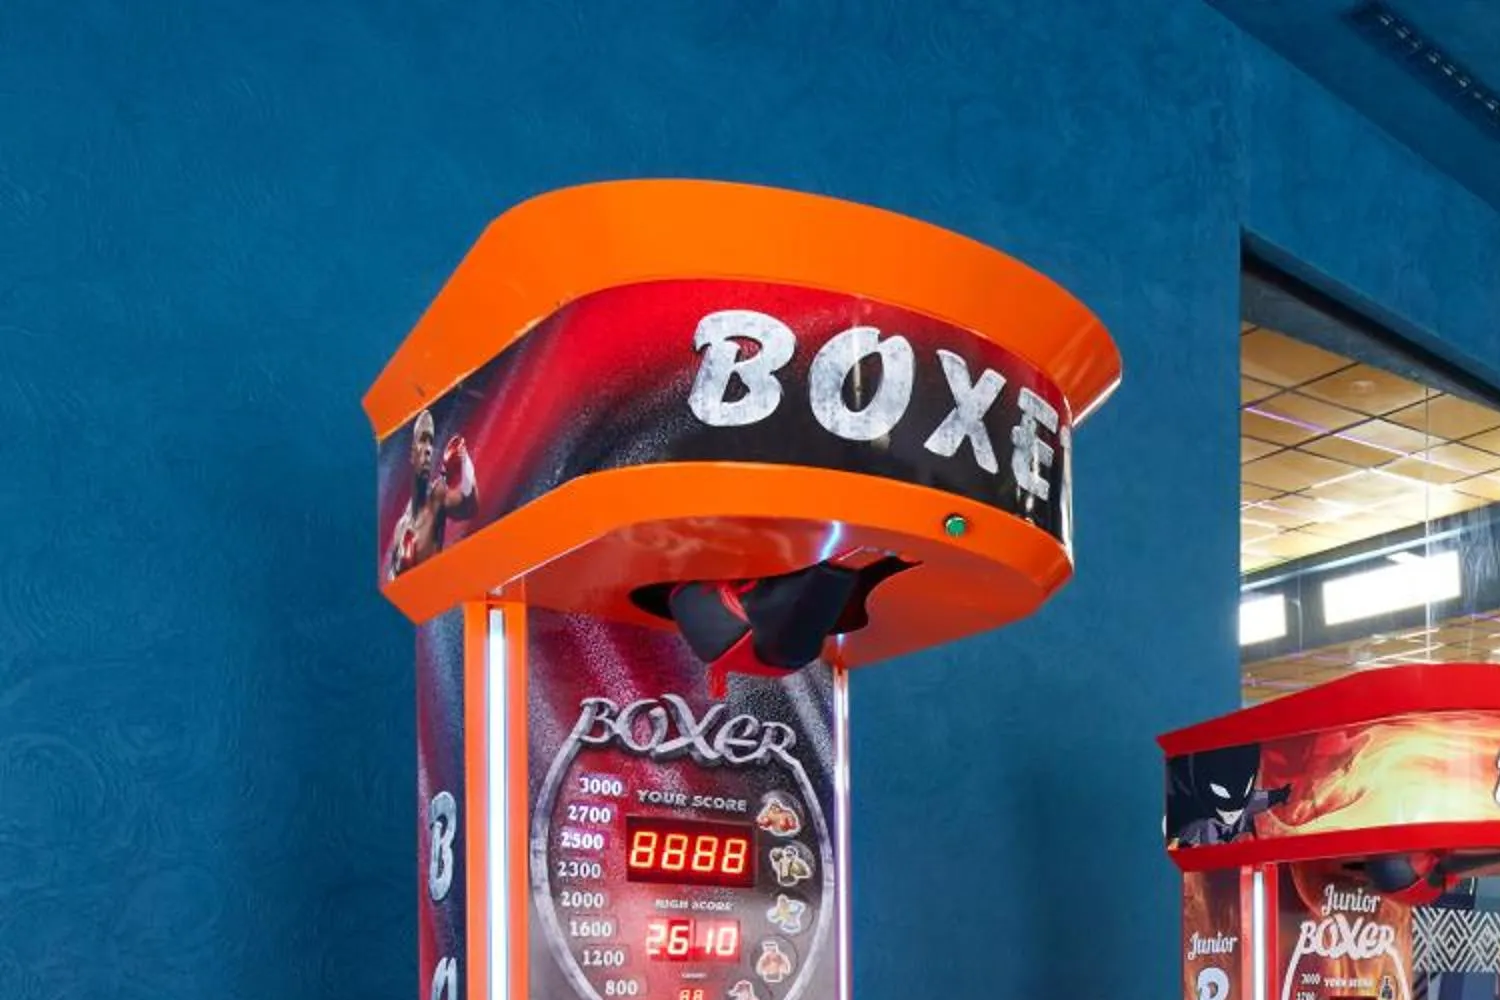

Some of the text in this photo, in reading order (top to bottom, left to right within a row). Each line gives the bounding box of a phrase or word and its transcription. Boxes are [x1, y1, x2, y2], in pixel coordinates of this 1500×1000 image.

[576, 693, 796, 764] BOXER
[579, 777, 623, 797] 3000
[637, 789, 747, 812] YOUR SCORE
[567, 804, 612, 824] 2700
[560, 831, 604, 849] 2500
[629, 830, 747, 874] 8888
[557, 861, 602, 878] 2300
[560, 890, 604, 908] 2000
[1321, 884, 1381, 916] Junior
[569, 920, 613, 938] 1600
[1300, 913, 1394, 960] BOXER
[645, 923, 738, 956] 2610
[582, 951, 625, 967] 1200
[604, 979, 639, 996] 800
